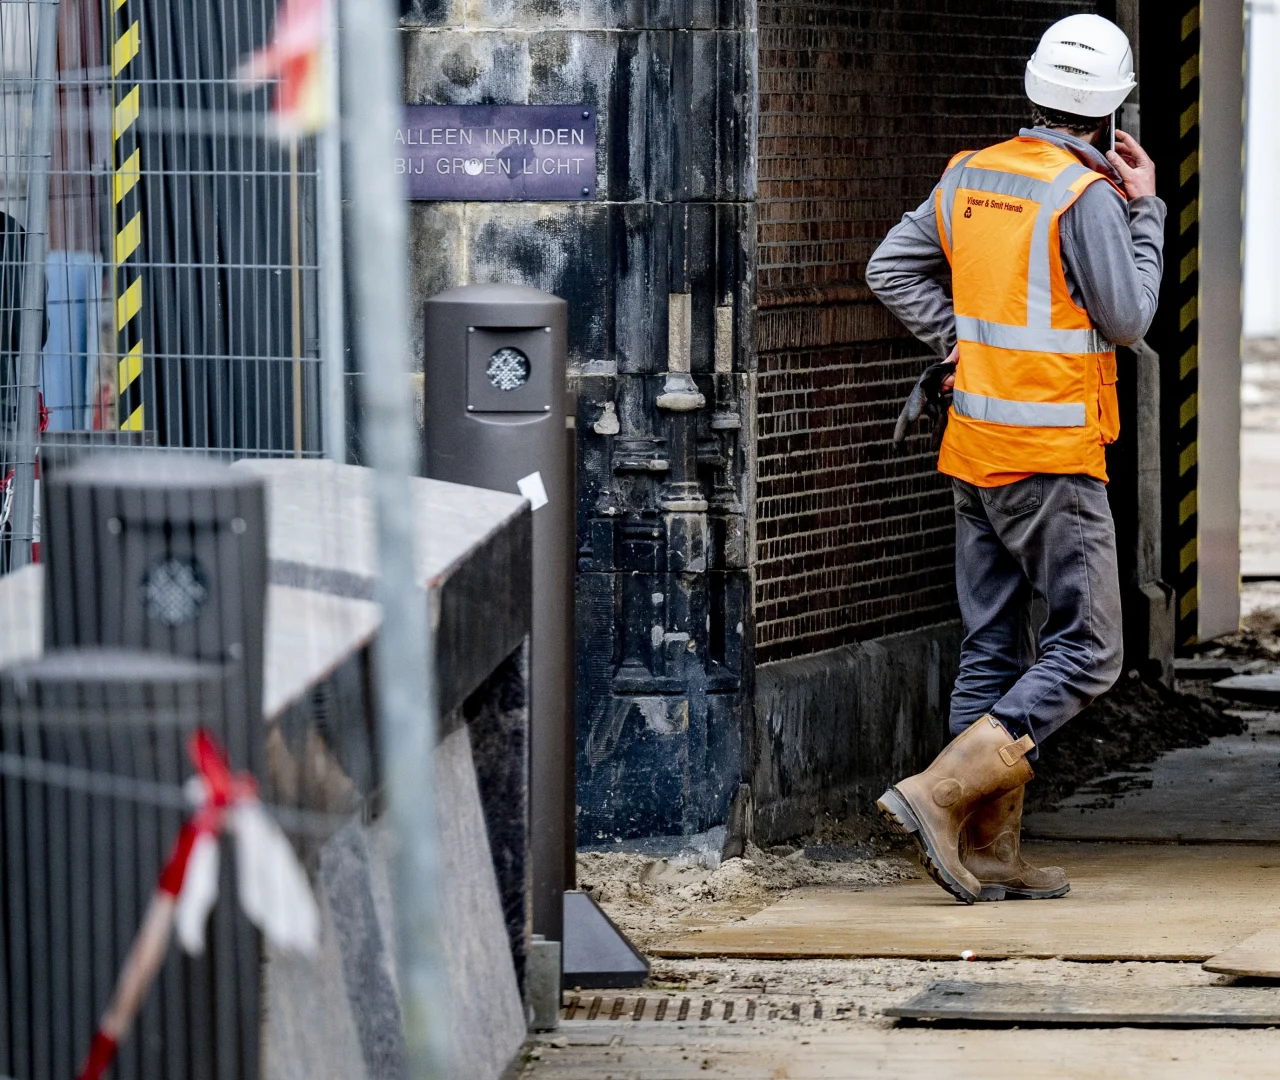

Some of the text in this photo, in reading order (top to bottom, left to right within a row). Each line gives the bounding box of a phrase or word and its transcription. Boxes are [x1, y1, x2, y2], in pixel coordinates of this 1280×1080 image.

[393, 128, 585, 145] ALLEEN INRIJDEN
[394, 157, 425, 174] BIJ
[523, 157, 585, 174] LICHT
[967, 196, 984, 207] Visser
[990, 200, 1004, 210] Smit
[1004, 202, 1023, 213] Hanab
